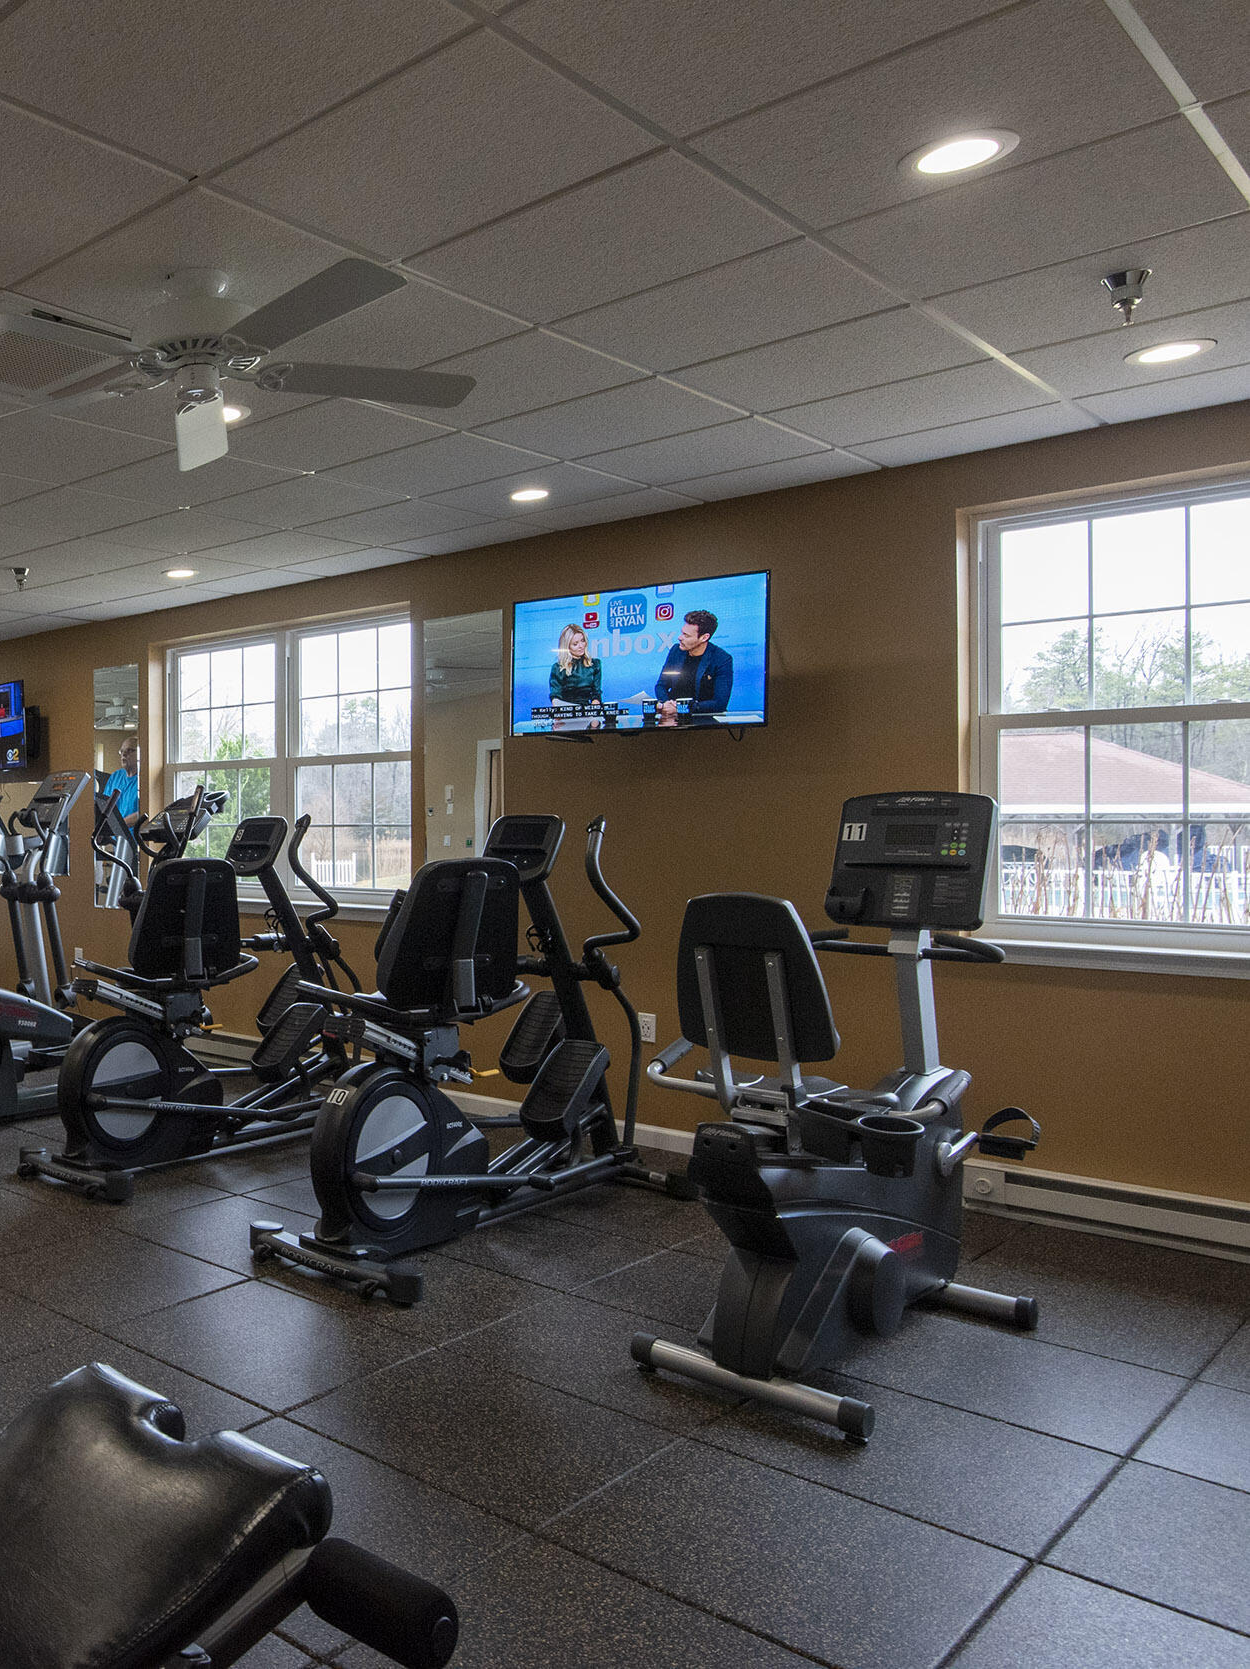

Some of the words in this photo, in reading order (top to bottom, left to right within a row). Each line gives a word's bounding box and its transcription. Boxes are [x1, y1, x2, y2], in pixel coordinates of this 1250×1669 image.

[610, 603, 642, 617] KELLY
[615, 614, 645, 628] RYAN
[590, 628, 677, 658] nbox
[844, 824, 865, 841] 11
[330, 1090, 347, 1105] 10
[281, 1247, 350, 1276] BODYCRAFT
